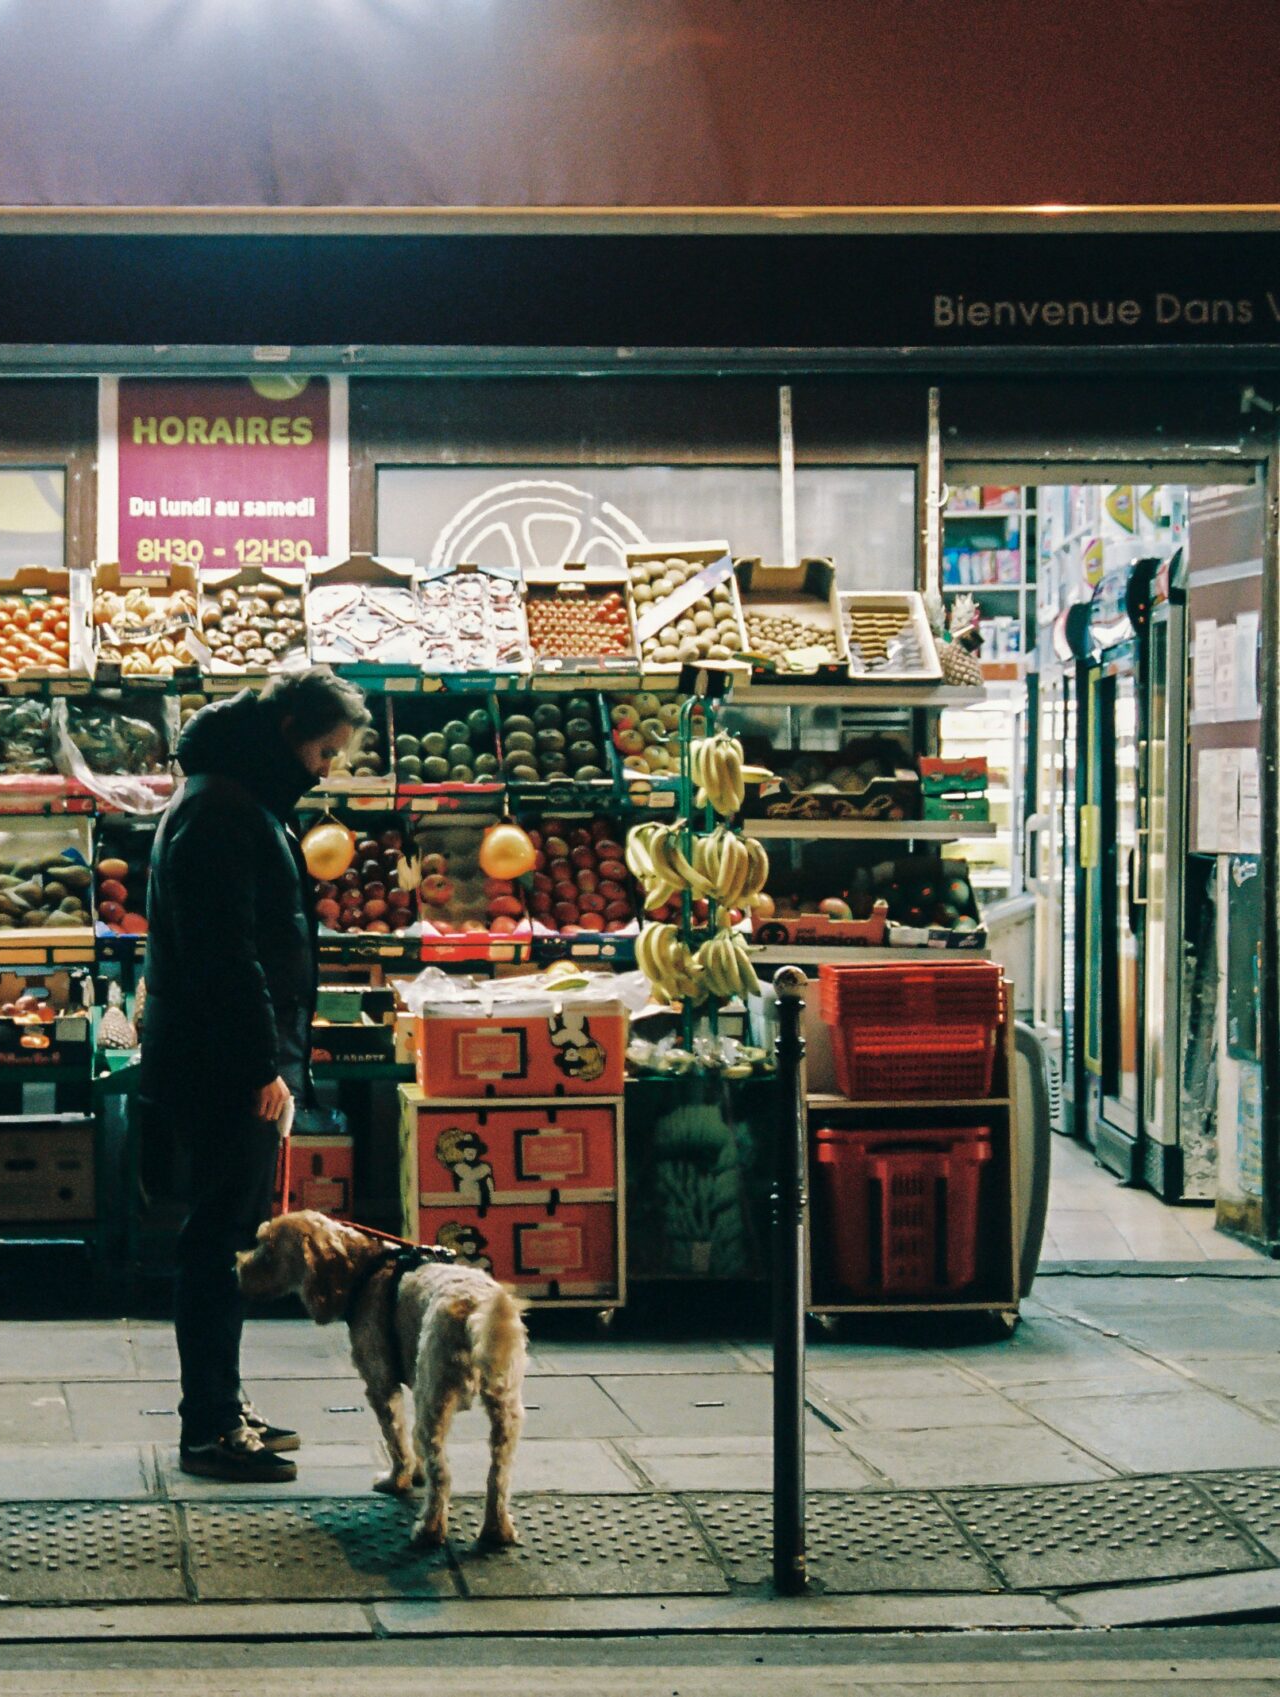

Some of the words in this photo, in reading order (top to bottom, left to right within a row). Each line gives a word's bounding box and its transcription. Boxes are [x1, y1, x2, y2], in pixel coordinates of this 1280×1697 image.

[933, 294, 1142, 327] Bienvenue
[1155, 292, 1253, 325] Dans
[132, 415, 314, 446] HORAIRES
[129, 497, 156, 517] Du
[160, 497, 211, 517] lundi
[214, 500, 240, 517] au
[243, 497, 315, 517] samedi
[137, 538, 204, 563] 8H30
[234, 538, 313, 563] 12H30
